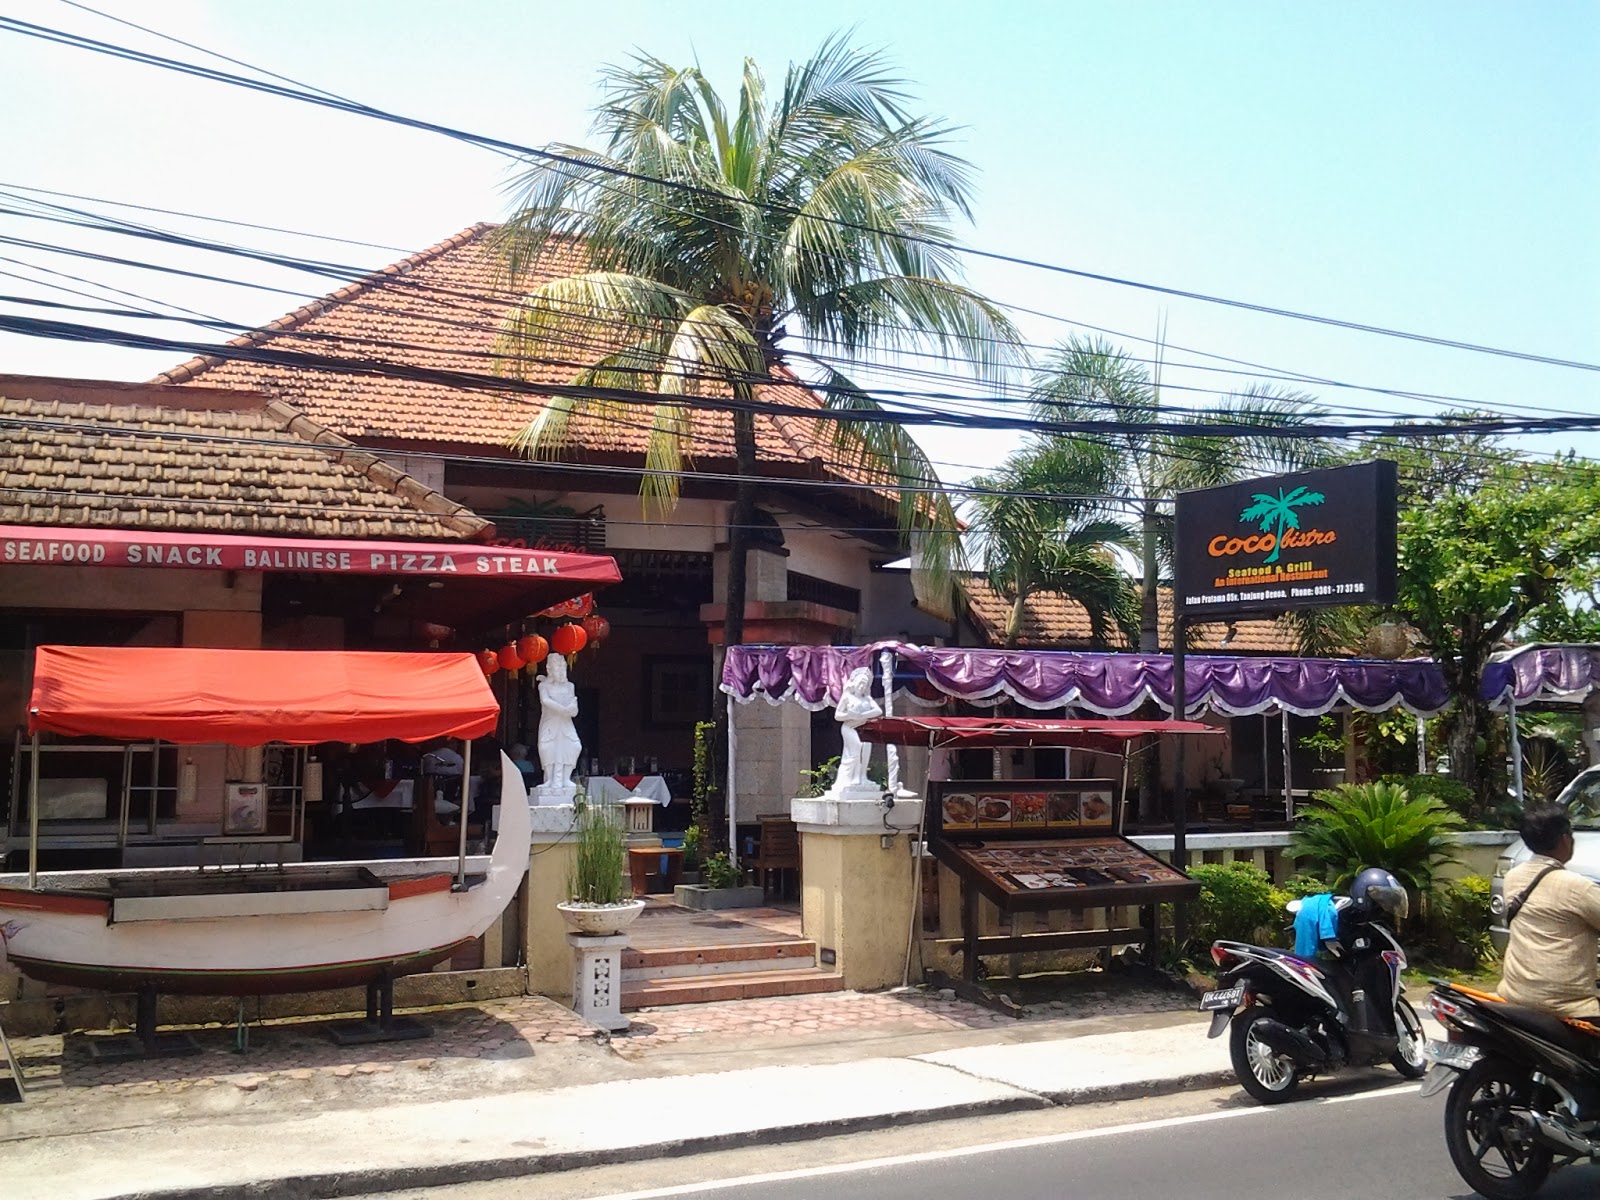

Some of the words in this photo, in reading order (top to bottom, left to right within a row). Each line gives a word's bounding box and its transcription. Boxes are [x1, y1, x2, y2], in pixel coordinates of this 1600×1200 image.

[1208, 533, 1277, 557] Coco
[1280, 527, 1337, 549] bistro
[4, 541, 106, 563] SEAFOOD
[127, 544, 223, 565] SNACK
[244, 549, 351, 570] BALINESE
[370, 552, 457, 572] PIZZA
[476, 556, 559, 575] STEAK
[1214, 577, 1225, 587] An
[1280, 568, 1328, 581] Restaurant
[1228, 565, 1272, 578] Seafood
[1275, 564, 1283, 573] &
[1286, 561, 1312, 573] Grill
[1185, 596, 1201, 605] Jalan
[1201, 594, 1226, 604] Pratama
[1240, 591, 1264, 601] Tanjung
[1290, 587, 1313, 597] Phone:
[1314, 585, 1332, 595] 0361
[1336, 584, 1344, 594] 77
